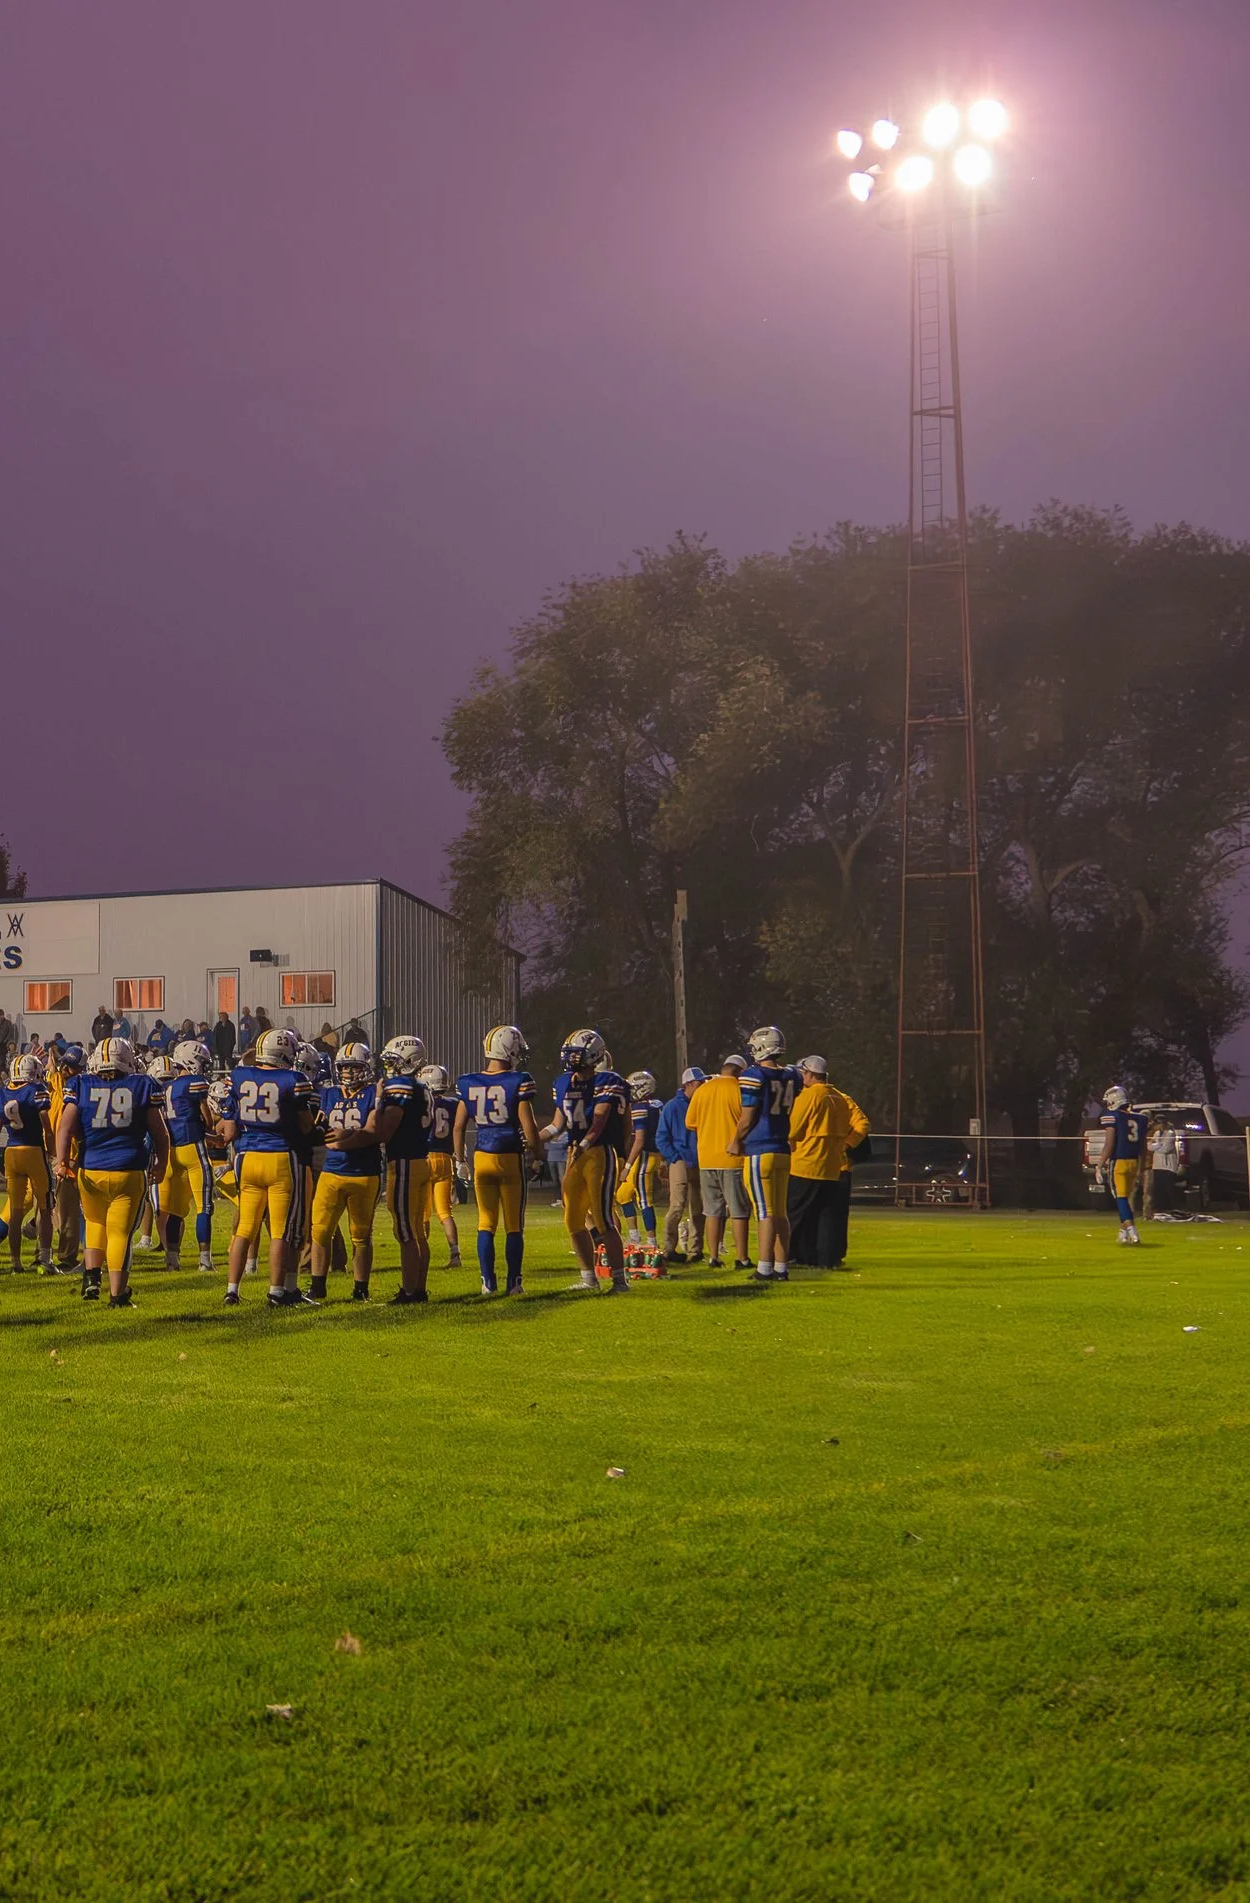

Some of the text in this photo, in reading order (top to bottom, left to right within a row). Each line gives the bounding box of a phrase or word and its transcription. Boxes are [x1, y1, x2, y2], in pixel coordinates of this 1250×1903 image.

[277, 1036, 289, 1046] 23
[90, 1088, 133, 1128] 79
[239, 1081, 280, 1123] 23
[469, 1086, 509, 1124] 73
[770, 1080, 794, 1115] 74
[4, 1100, 24, 1130] 9
[563, 1099, 588, 1130] 54
[1127, 1119, 1139, 1142] 3
